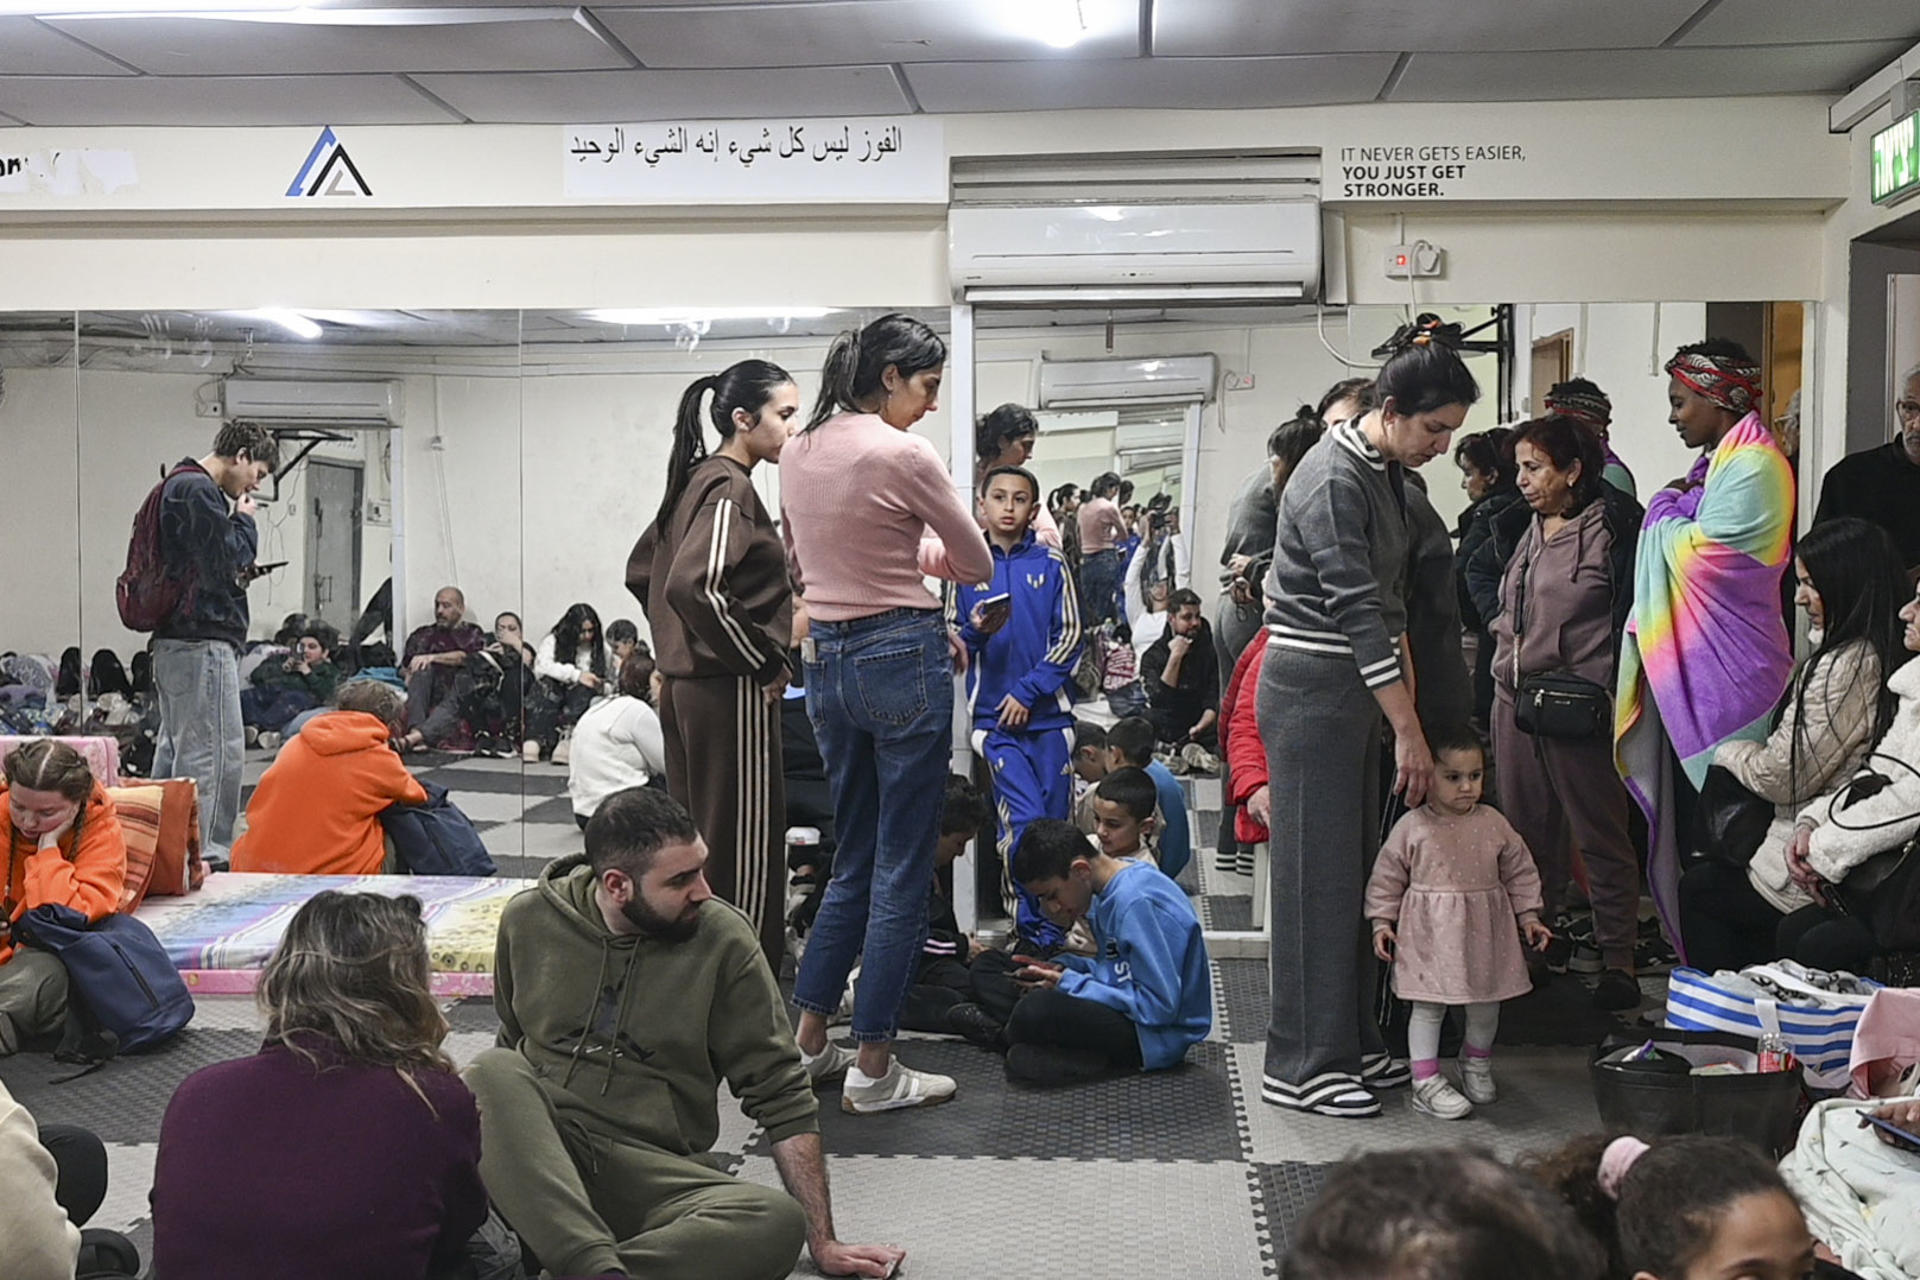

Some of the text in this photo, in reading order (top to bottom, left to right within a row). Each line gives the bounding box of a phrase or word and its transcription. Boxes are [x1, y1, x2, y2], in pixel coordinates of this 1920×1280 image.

[570, 125, 902, 168] الفوز ليس كل شيء إنه الشيء الوحيد
[1341, 145, 1527, 162] IT NEVER GETS EASIER,
[1342, 165, 1467, 180] YOU JUST GET
[1343, 182, 1445, 197] STRONGER.
